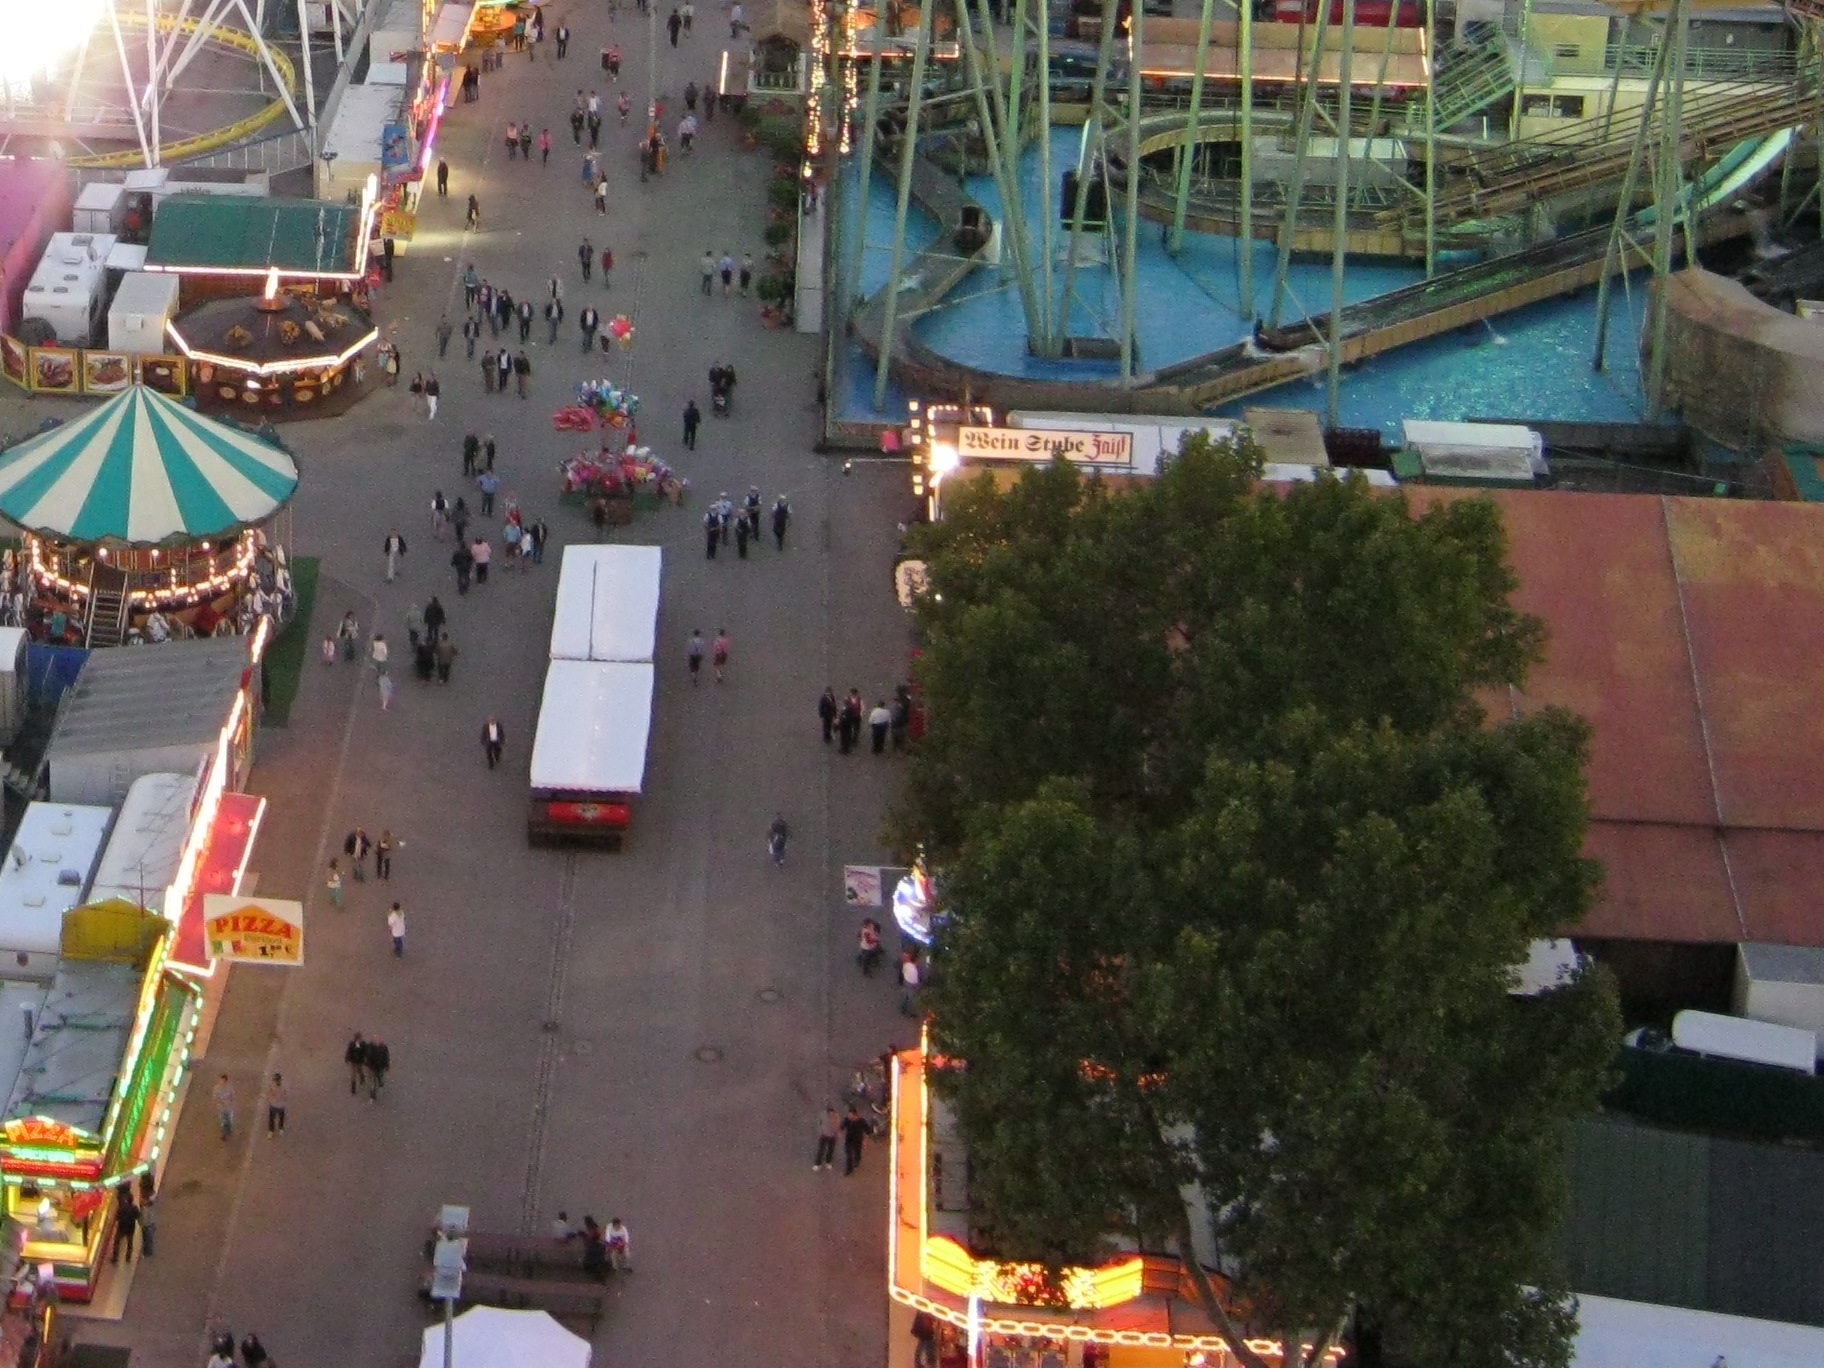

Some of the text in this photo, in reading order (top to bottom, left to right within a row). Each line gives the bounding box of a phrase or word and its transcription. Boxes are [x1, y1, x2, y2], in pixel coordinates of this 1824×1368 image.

[965, 431, 1019, 450] Wein
[1025, 434, 1084, 453] Stube
[214, 915, 293, 940] PIZZA
[5, 1118, 75, 1146] PIZZA
